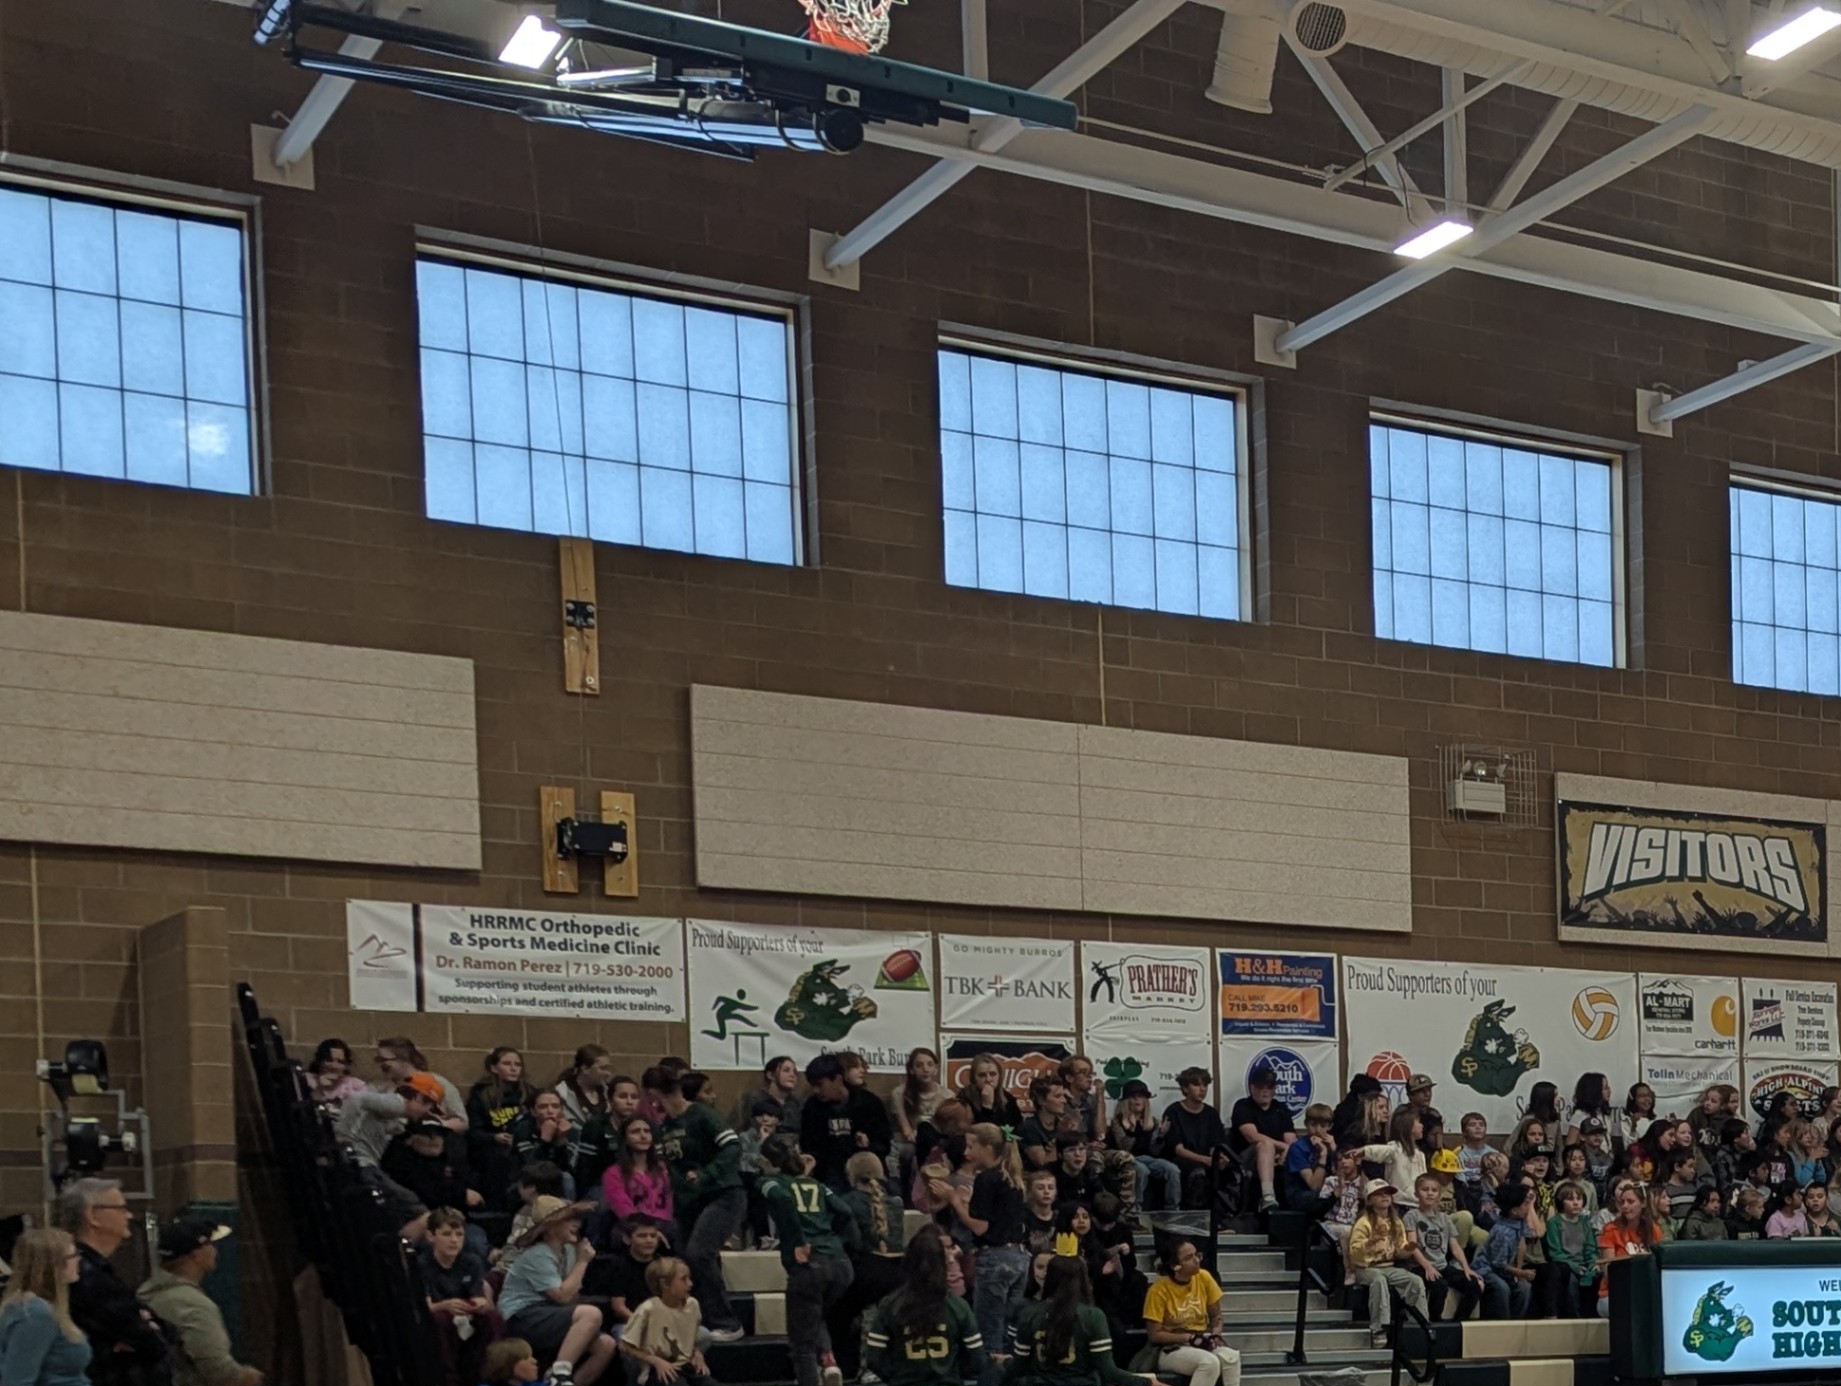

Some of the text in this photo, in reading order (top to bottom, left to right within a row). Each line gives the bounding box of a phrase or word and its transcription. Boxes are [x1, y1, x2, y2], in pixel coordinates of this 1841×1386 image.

[1582, 822, 1807, 914] VISITORS
[470, 914, 640, 938] HRRMC Orthopedic
[449, 932, 661, 956] & Sports Medicine Clinic
[692, 928, 823, 958] Proud Supporters of your
[953, 944, 1062, 957] GO MIGHTY BURROS
[436, 955, 459, 969] Dr.
[463, 956, 517, 971] Ramon
[521, 959, 562, 973] Perez
[573, 962, 673, 978] 719-530-2000
[1235, 957, 1283, 974] H&H
[455, 978, 657, 997] Supporting student athletes through
[944, 976, 1072, 1000] TBK BANK
[1127, 964, 1198, 996] PRATHER'S
[1347, 965, 1497, 1001] Proud Supporters of your
[515, 997, 536, 1006] and
[539, 998, 584, 1009] certified
[587, 1000, 627, 1011] athletic
[629, 1002, 674, 1015] training.
[1695, 1039, 1736, 1050] carhartt
[1648, 1068, 1733, 1080] Tolin Mechanical
[1275, 1081, 1296, 1094] ark
[1757, 1078, 1783, 1096] HIGH
[791, 1182, 820, 1213] 17
